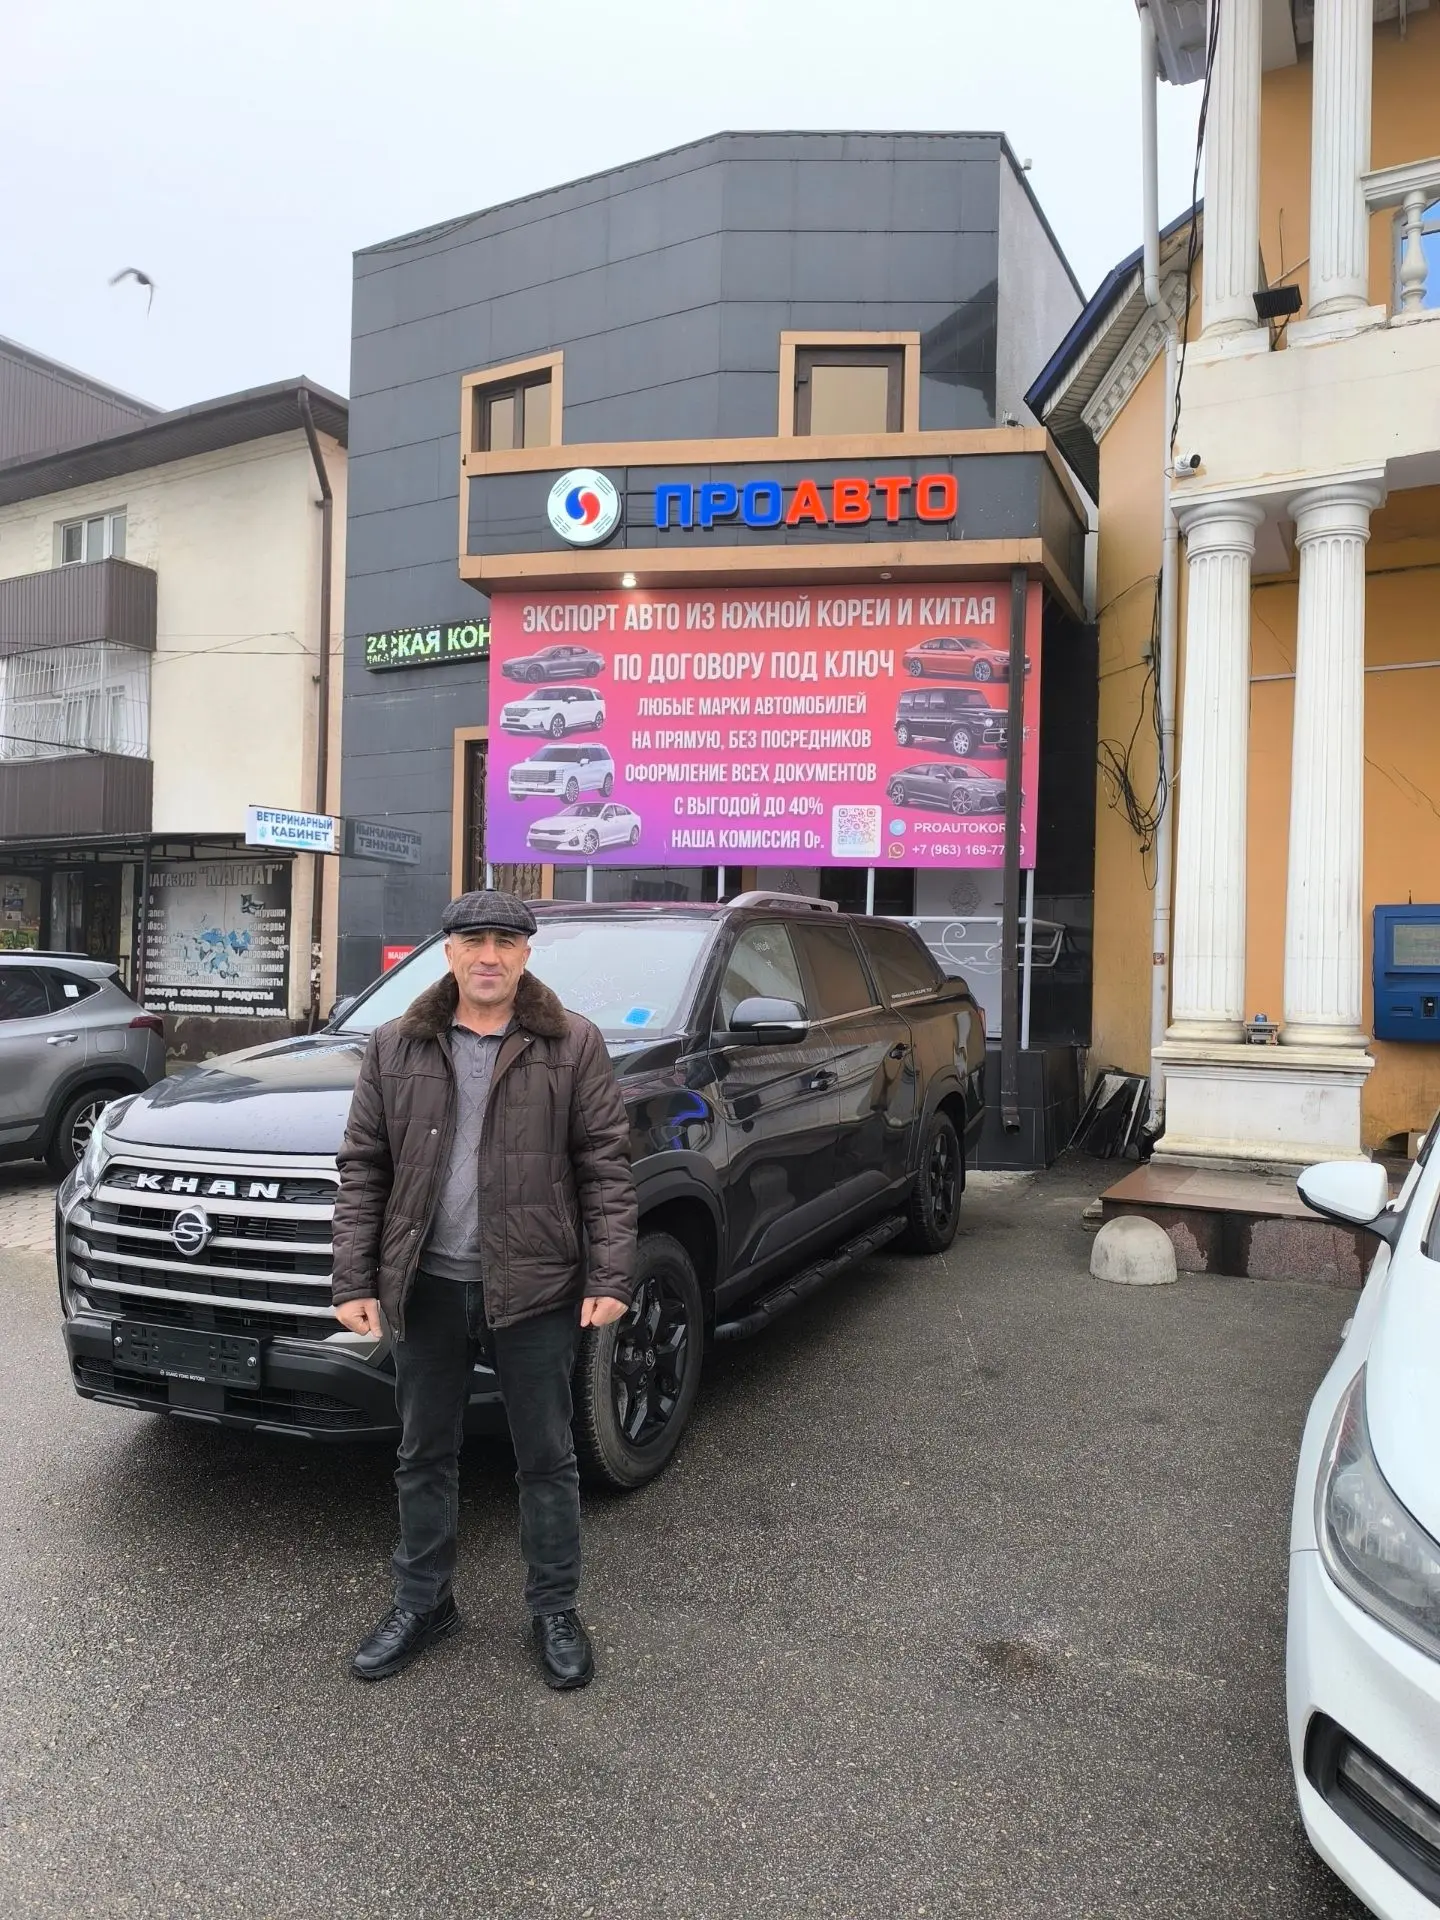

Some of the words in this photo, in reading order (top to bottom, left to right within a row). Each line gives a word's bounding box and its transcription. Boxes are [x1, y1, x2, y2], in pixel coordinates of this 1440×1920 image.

[655, 474, 959, 530] ПРОАВТО
[523, 604, 619, 632] ЭКСПОРТ
[624, 603, 680, 631] АВТО
[686, 603, 715, 630] ИЗ
[722, 595, 810, 629] ЮЖНОЙ
[817, 599, 891, 627] КОРЕИ
[897, 598, 913, 625] И
[919, 597, 996, 626] КИТАЯ
[367, 634, 388, 654] 24
[613, 653, 642, 681] ПО
[647, 652, 764, 684] ДОГОВОРУ
[770, 651, 819, 682] ПОД
[824, 649, 895, 678] КЛЮЧ
[637, 697, 694, 716] ЛЮБЫЕ
[699, 696, 750, 715] МАРКИ
[753, 691, 867, 715] АВТОМОБИЛЕЙ
[632, 731, 651, 749] НА
[728, 730, 757, 749] БЕЗ
[761, 729, 872, 751] ПОСРЕДНИКОВ
[625, 763, 728, 782] ОФОРМЛЕНИЕ
[731, 763, 771, 782] ВСЕХ
[773, 763, 877, 784] ДОКУМЕНТОВ
[674, 797, 684, 815] С
[687, 793, 760, 817] ВЫГОДОЙ
[763, 796, 785, 817] ДО
[788, 796, 824, 815] 40%
[256, 811, 333, 829] ВЕТЕРИНАРНЫЙ
[914, 823, 1027, 834] PROAUTOKORA
[271, 826, 330, 842] КАБИНЕТ
[671, 829, 716, 848] НАША
[719, 829, 800, 848] КОМИССИЯ
[912, 845, 926, 855] +7
[931, 844, 961, 857] (963)
[966, 845, 1025, 856] 169-779
[136, 1173, 280, 1199] KHAN
